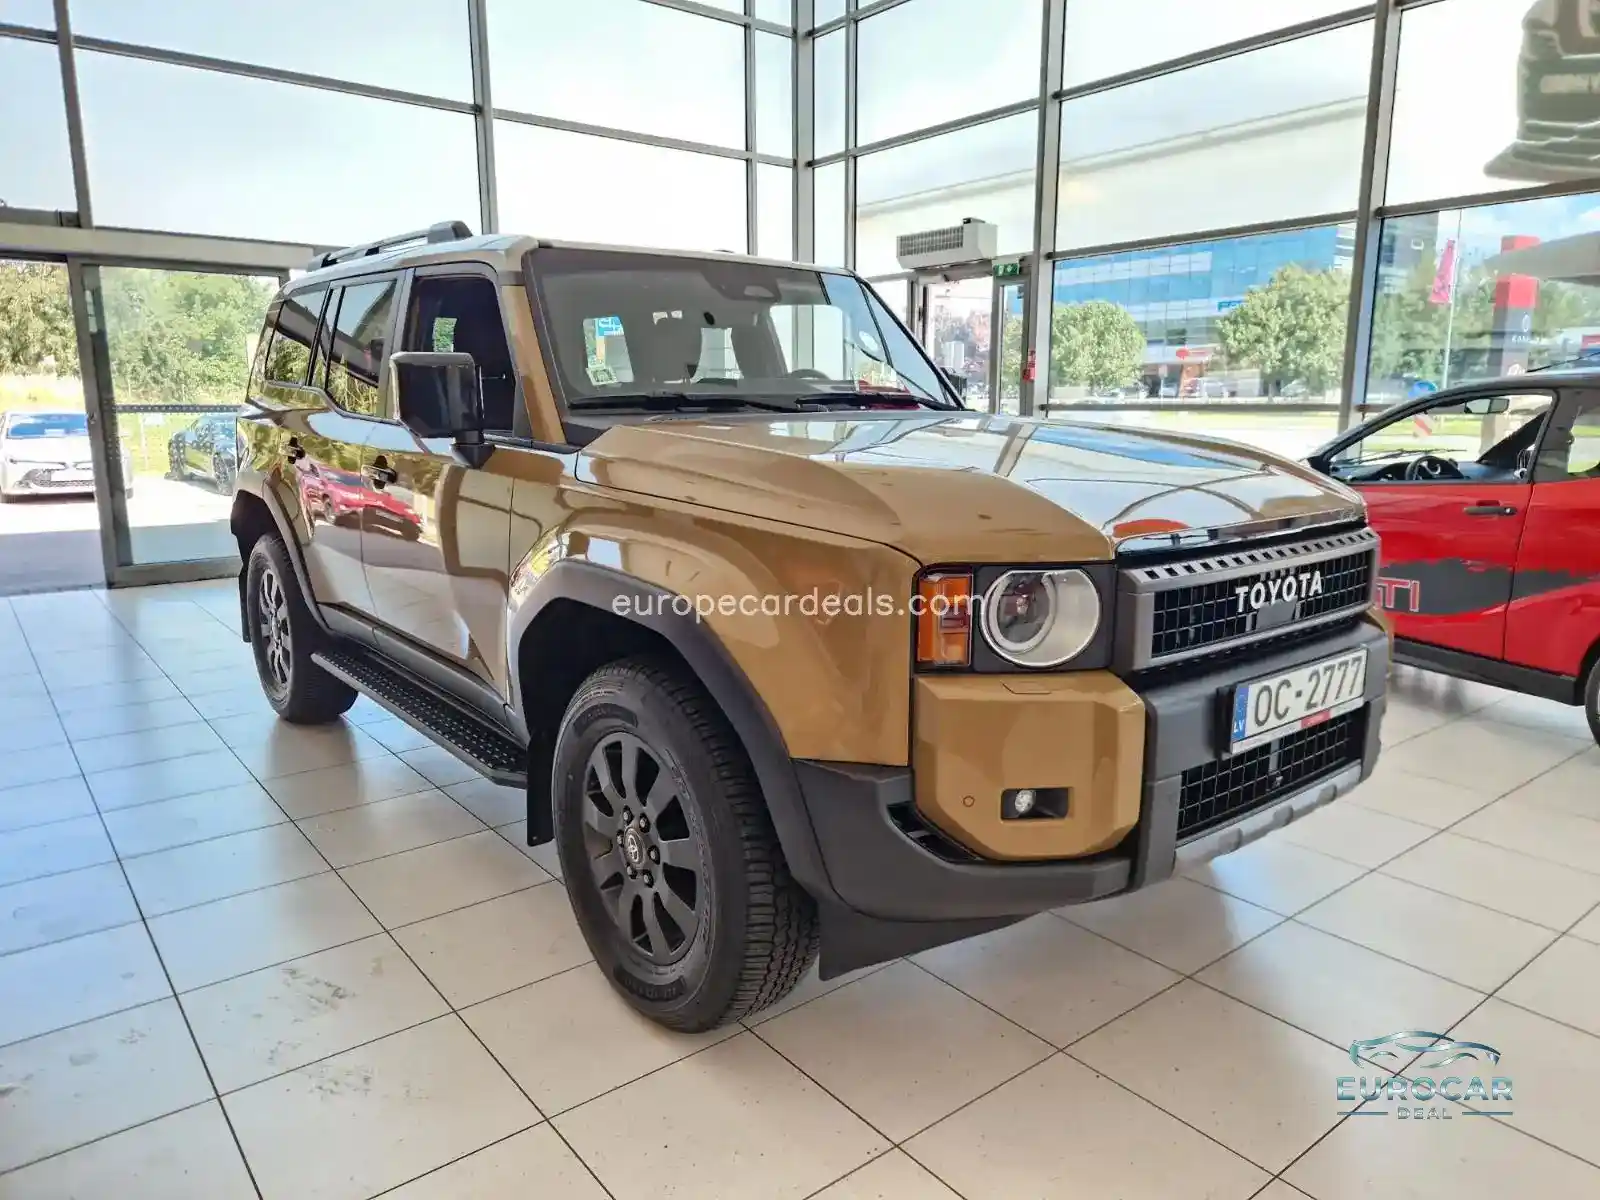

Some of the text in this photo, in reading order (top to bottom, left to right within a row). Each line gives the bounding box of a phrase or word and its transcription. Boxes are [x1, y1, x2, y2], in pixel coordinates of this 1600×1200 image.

[1235, 570, 1322, 612] TOYOTA
[1374, 577, 1420, 612] TI
[1254, 656, 1363, 727] OC-2777
[1232, 719, 1245, 733] LV
